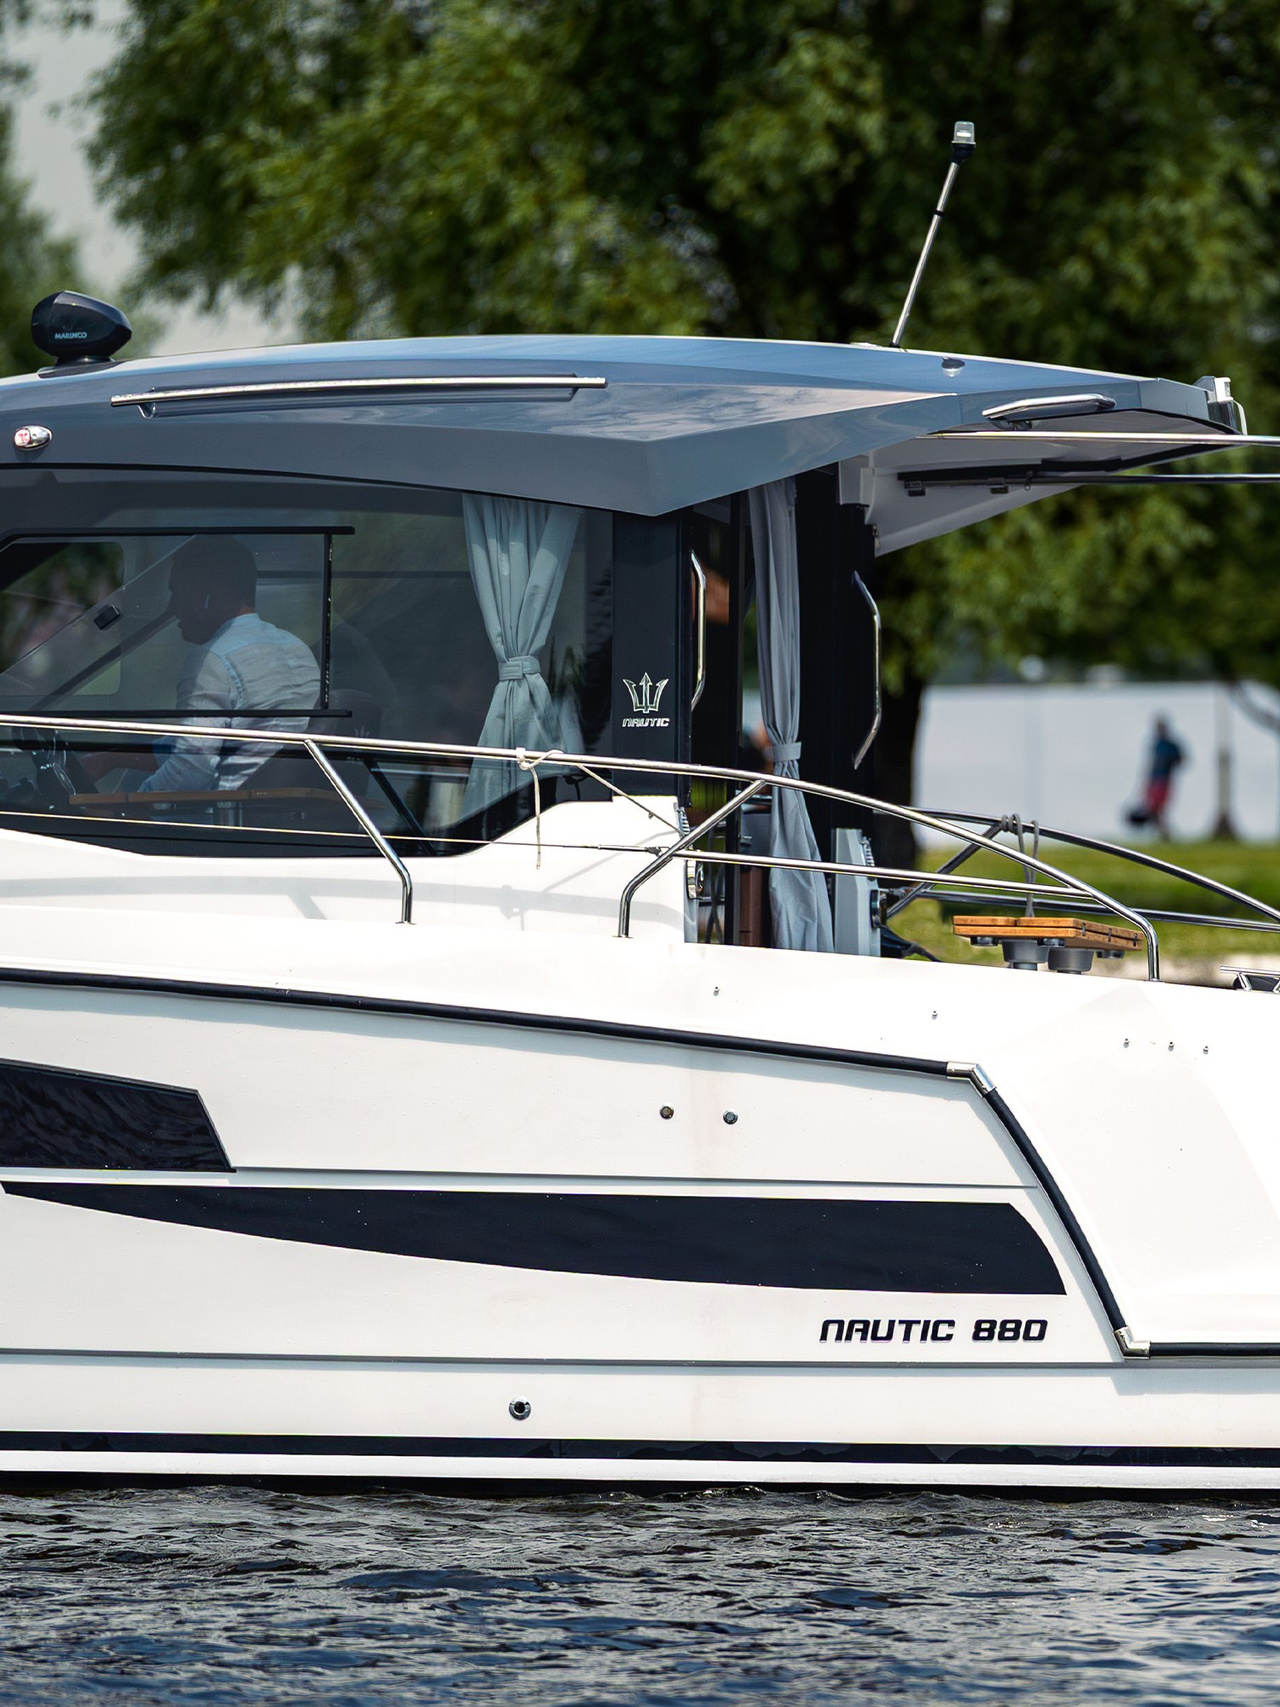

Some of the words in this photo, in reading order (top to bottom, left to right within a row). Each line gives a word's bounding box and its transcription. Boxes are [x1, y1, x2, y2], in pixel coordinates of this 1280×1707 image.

[622, 717, 670, 728] NAUTIC
[819, 1319, 956, 1343] NAUTIC
[972, 1319, 1049, 1343] 880
